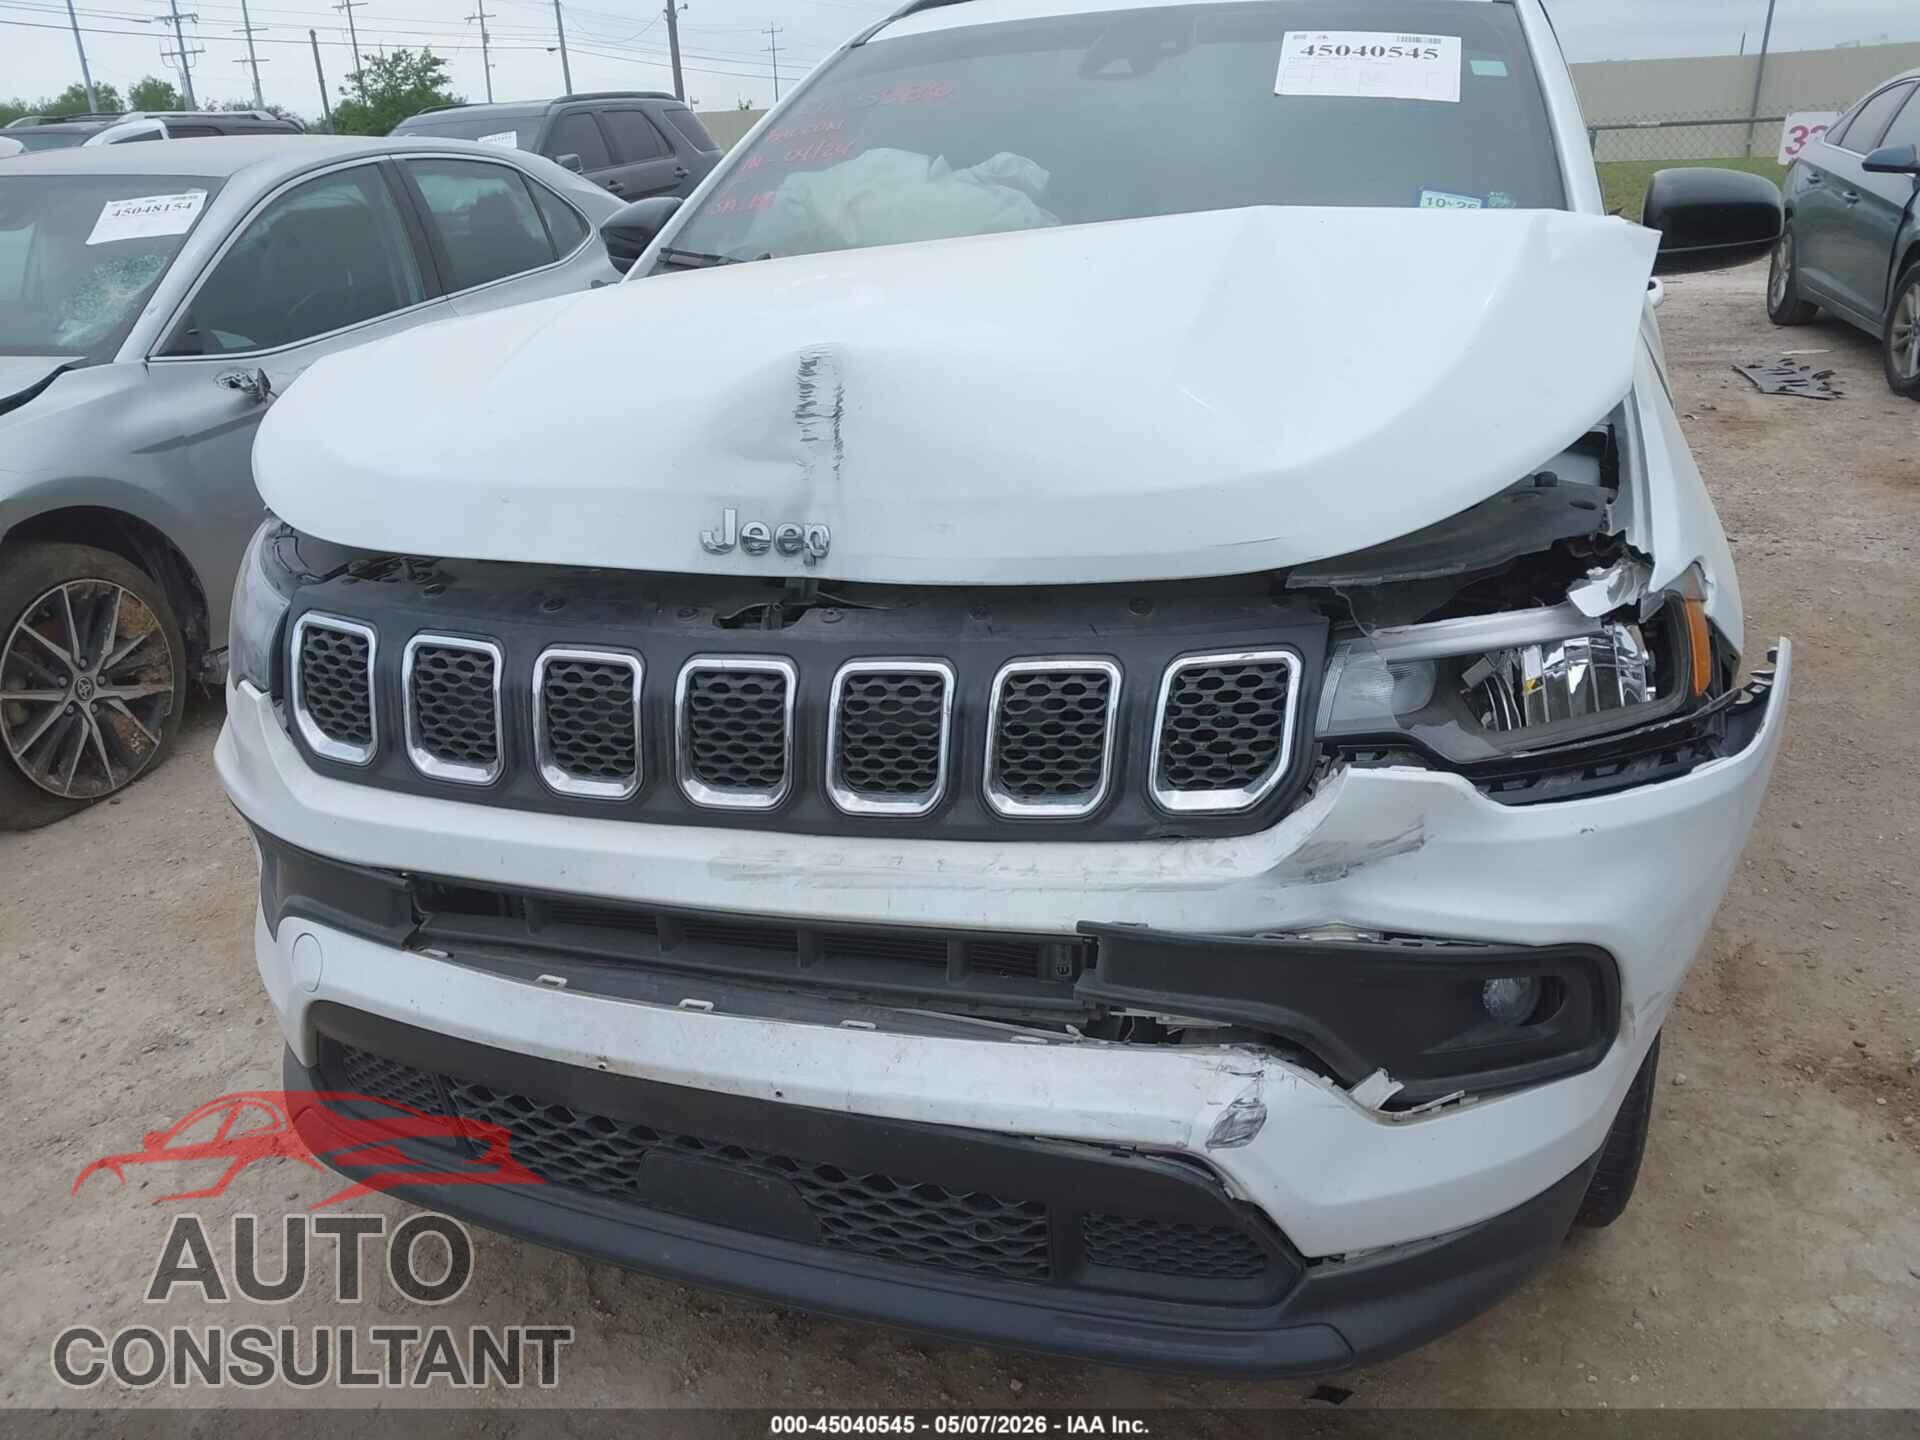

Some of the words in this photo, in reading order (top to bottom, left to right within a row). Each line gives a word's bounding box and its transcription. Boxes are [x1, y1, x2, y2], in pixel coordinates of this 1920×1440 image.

[1299, 44, 1440, 60] 45040545
[111, 202, 193, 217] 45048154
[700, 508, 831, 567] Jeep
